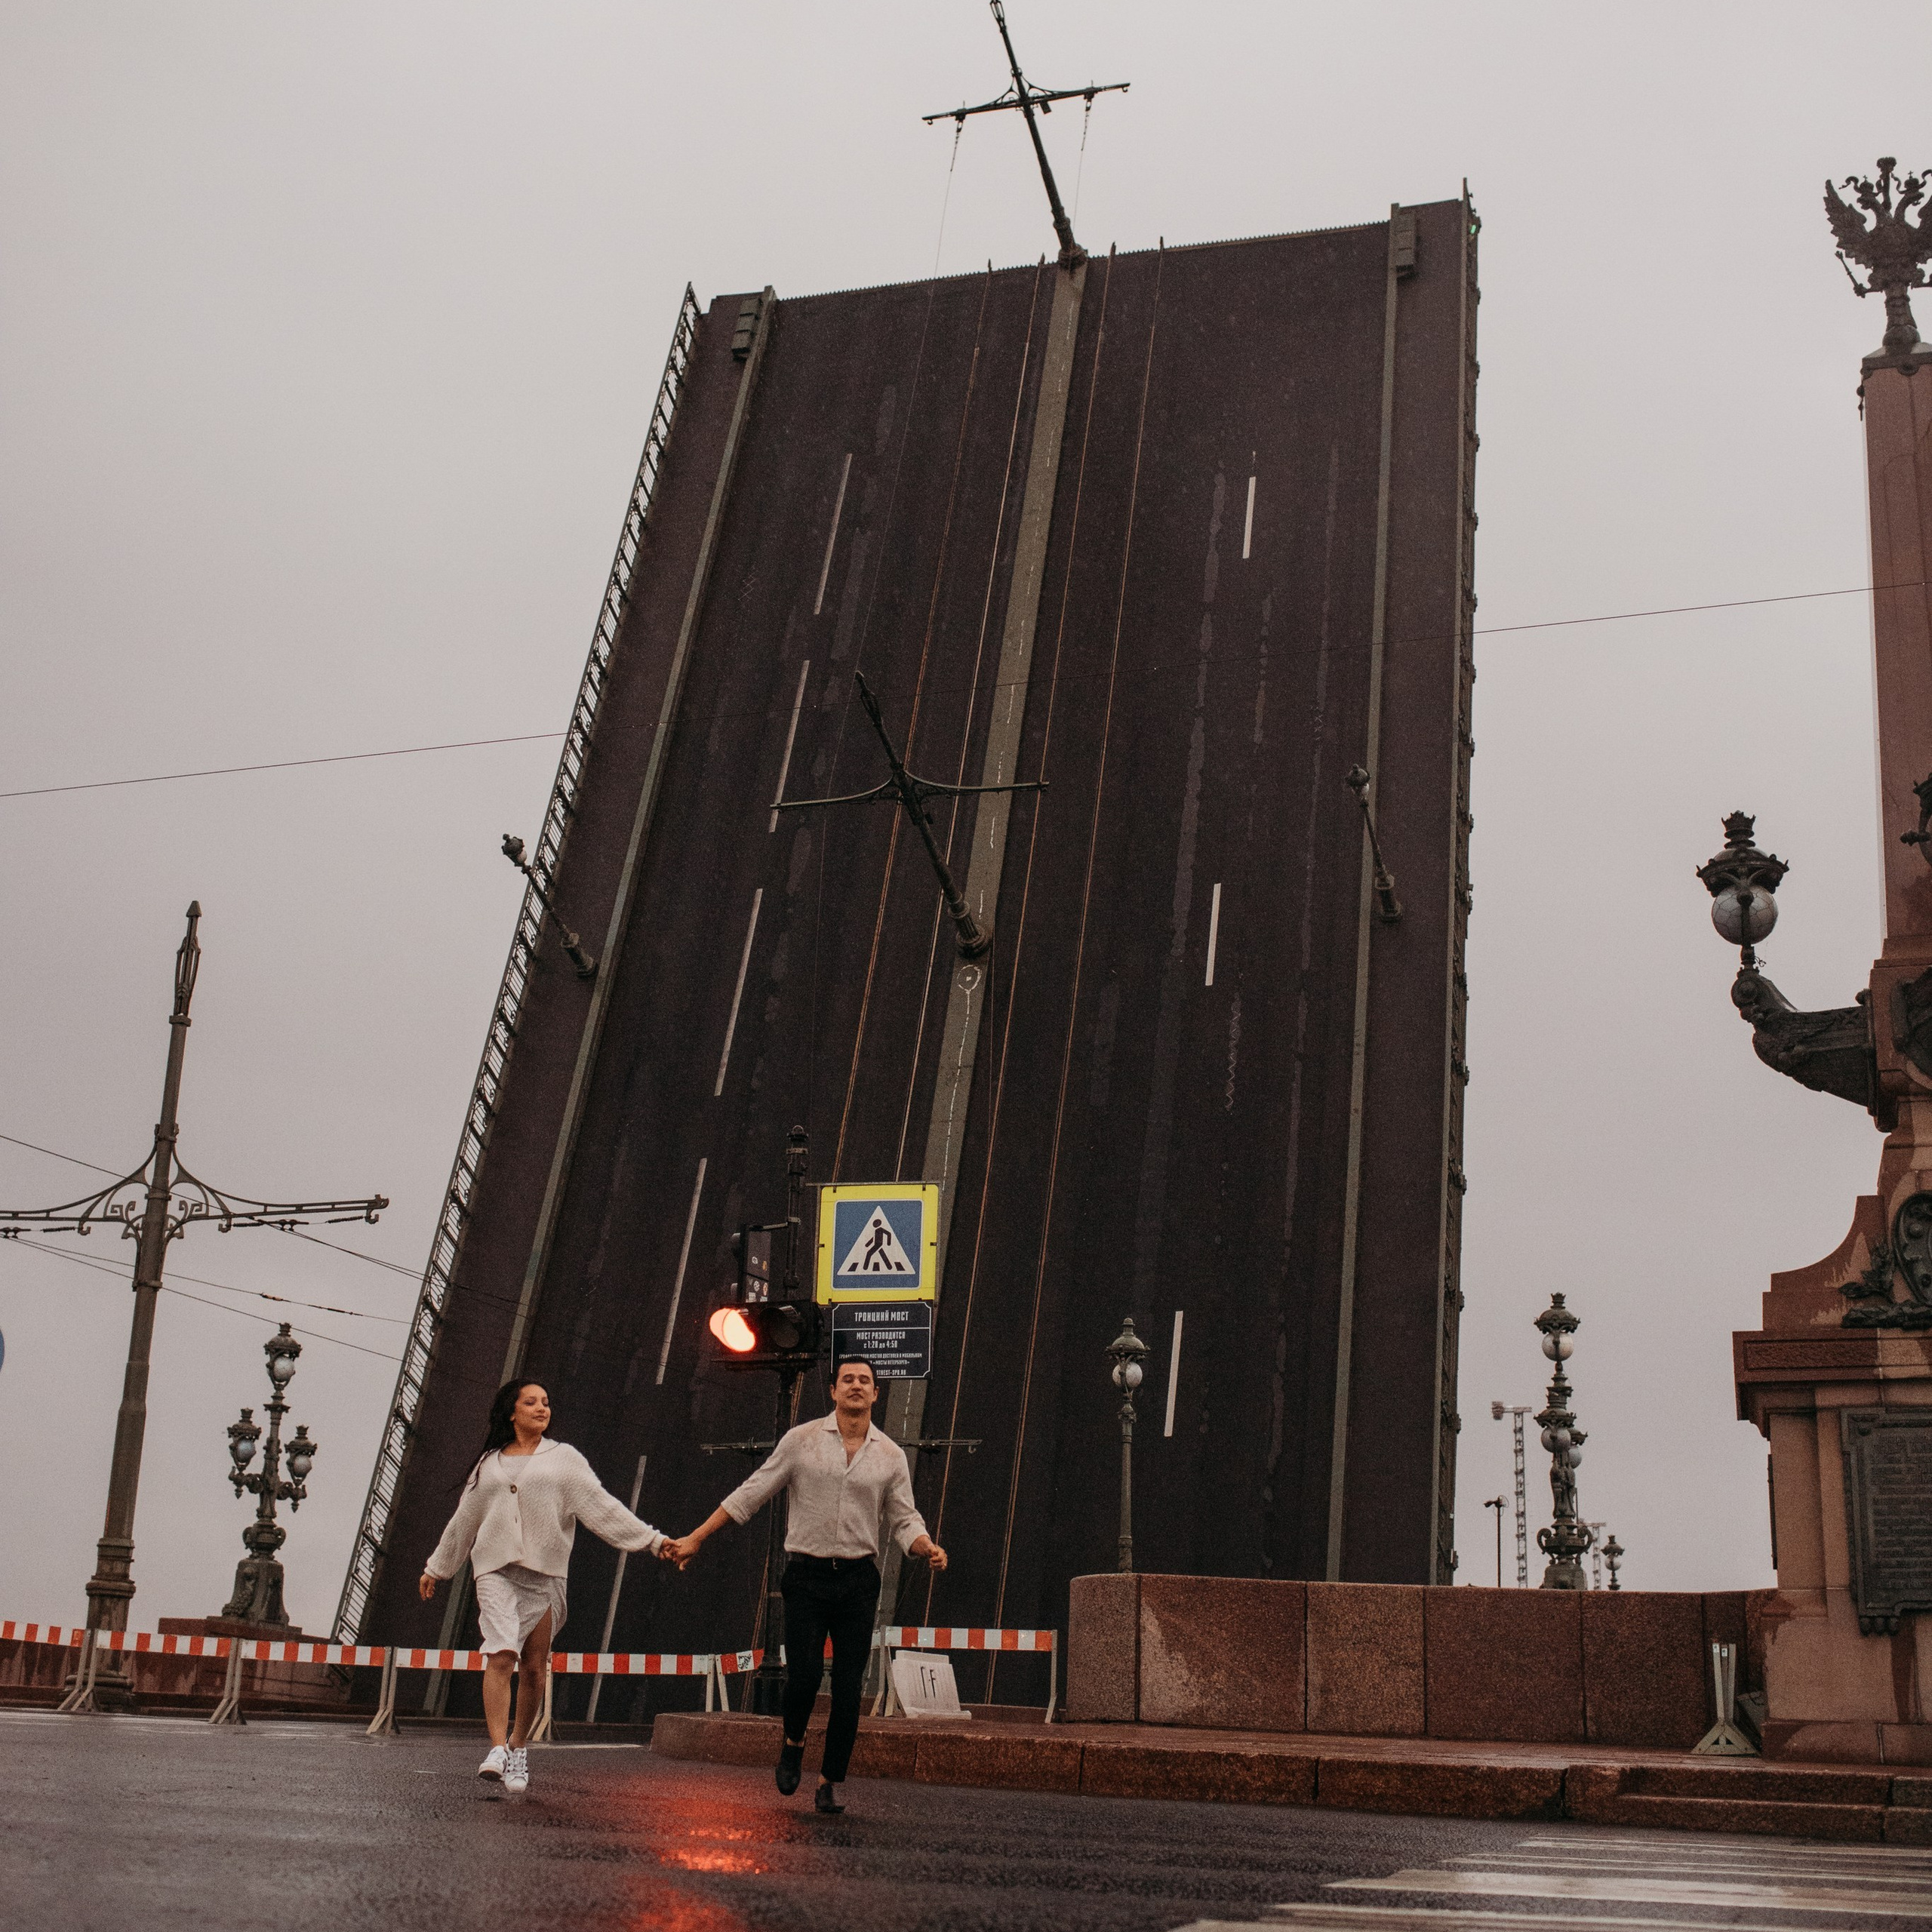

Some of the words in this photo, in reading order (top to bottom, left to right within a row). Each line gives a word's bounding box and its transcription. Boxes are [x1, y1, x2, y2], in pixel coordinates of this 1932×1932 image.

[854, 1309, 889, 1322] ТРОИЦКИЙ
[891, 1311, 909, 1321] МОСТ
[872, 1331, 906, 1340] РАЗВОДИТСЯ
[868, 1340, 878, 1349] 1:20
[886, 1340, 898, 1349] 4:50
